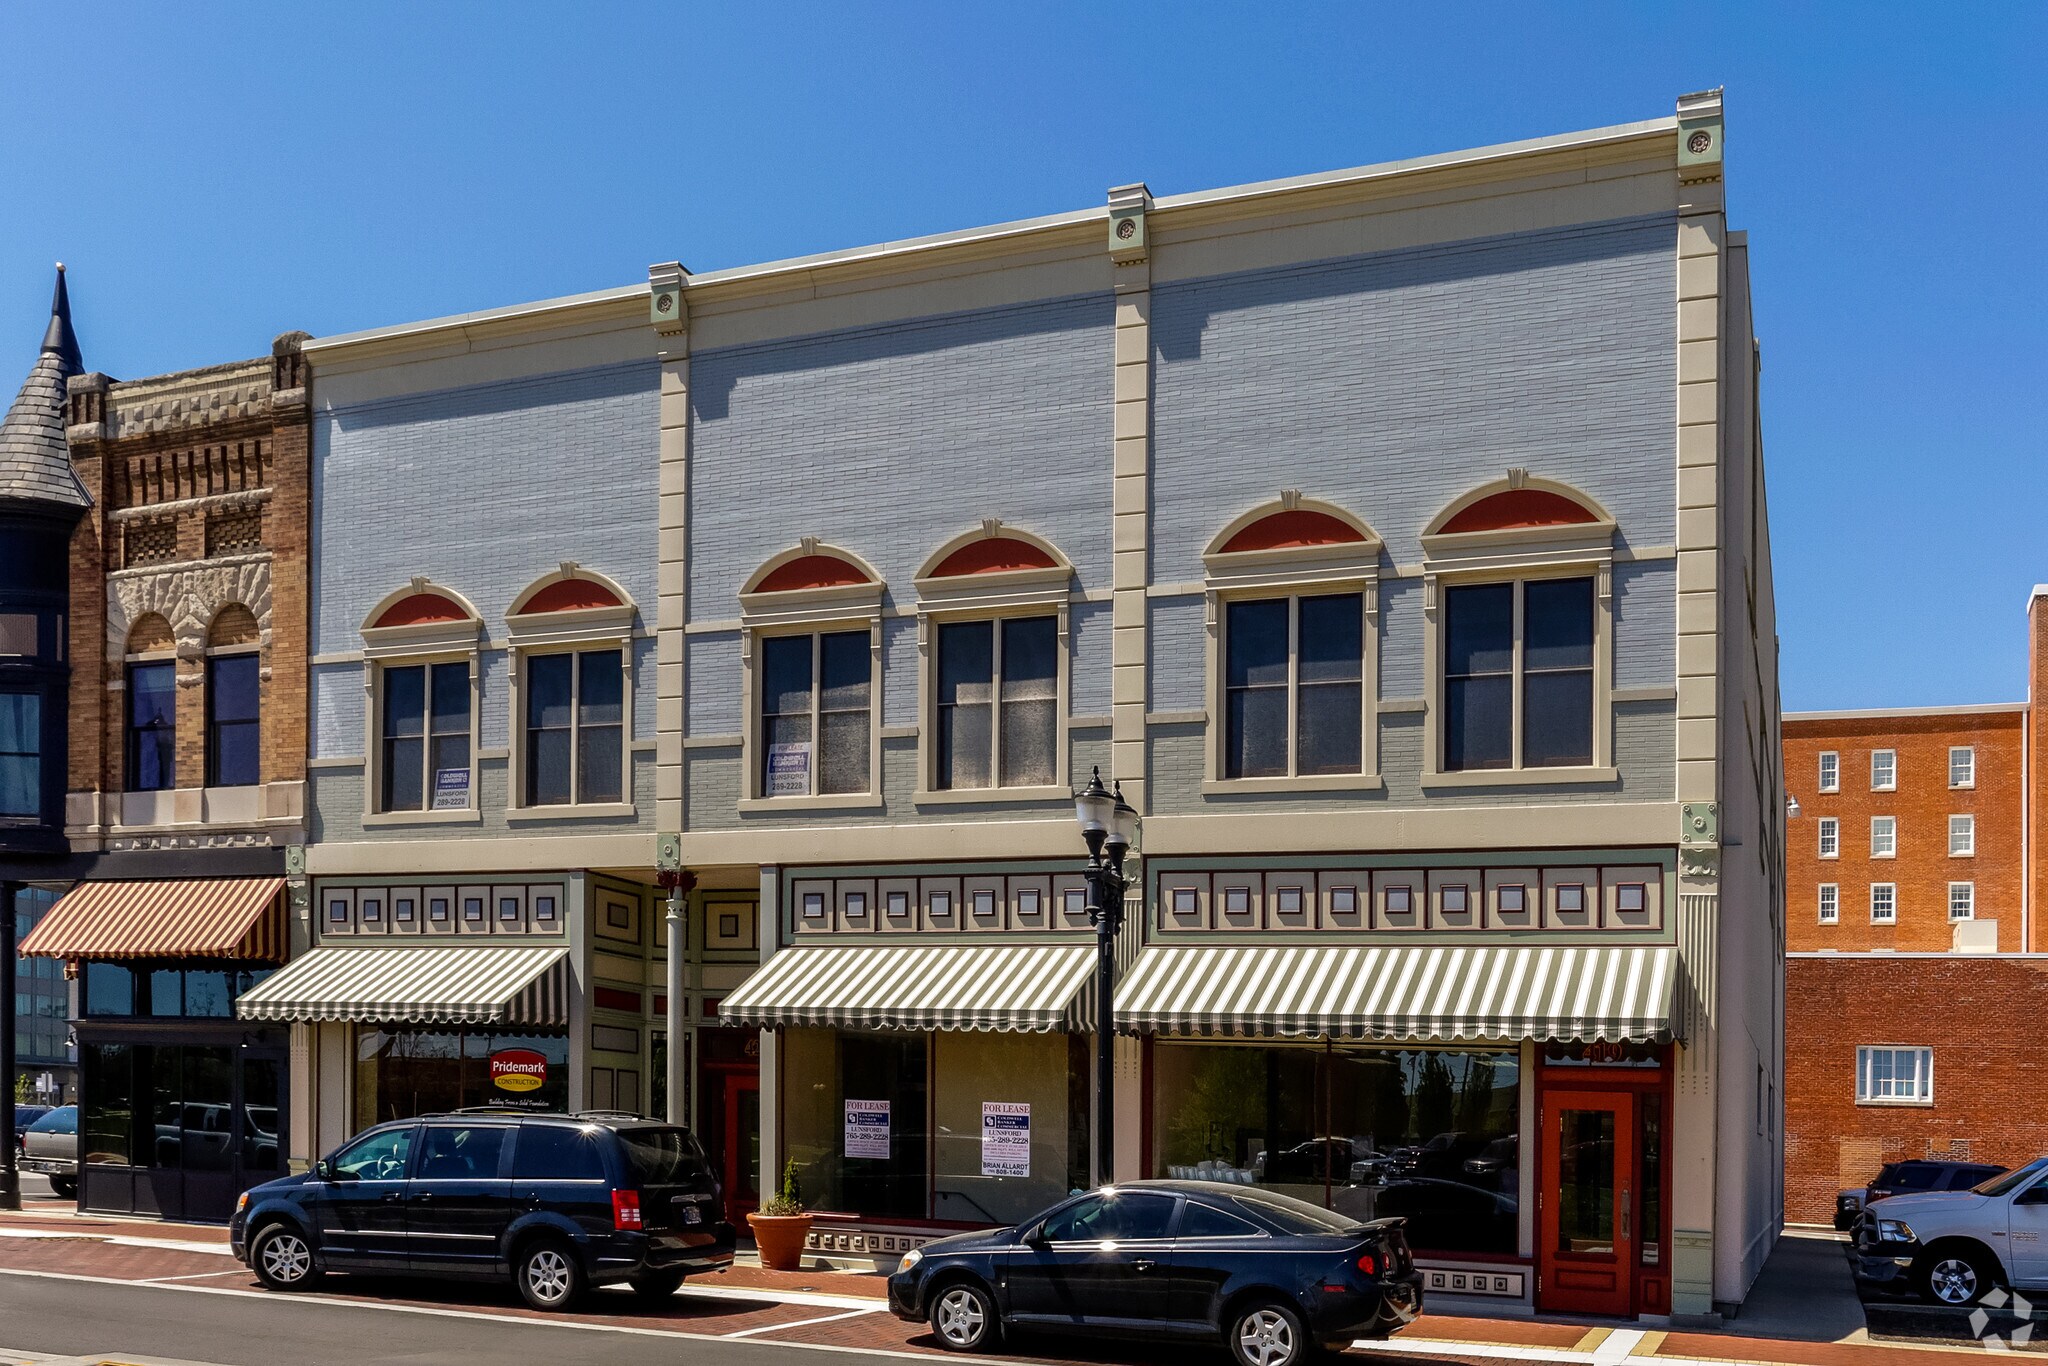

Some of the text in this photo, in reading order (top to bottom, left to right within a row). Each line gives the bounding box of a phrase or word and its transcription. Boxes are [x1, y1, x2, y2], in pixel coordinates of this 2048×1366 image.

[493, 1061, 544, 1073] Pridemark
[846, 1101, 889, 1110] FOR LEASE
[984, 1104, 1029, 1113] FOR LEASE
[1001, 1162, 1028, 1170] ALLARDT
